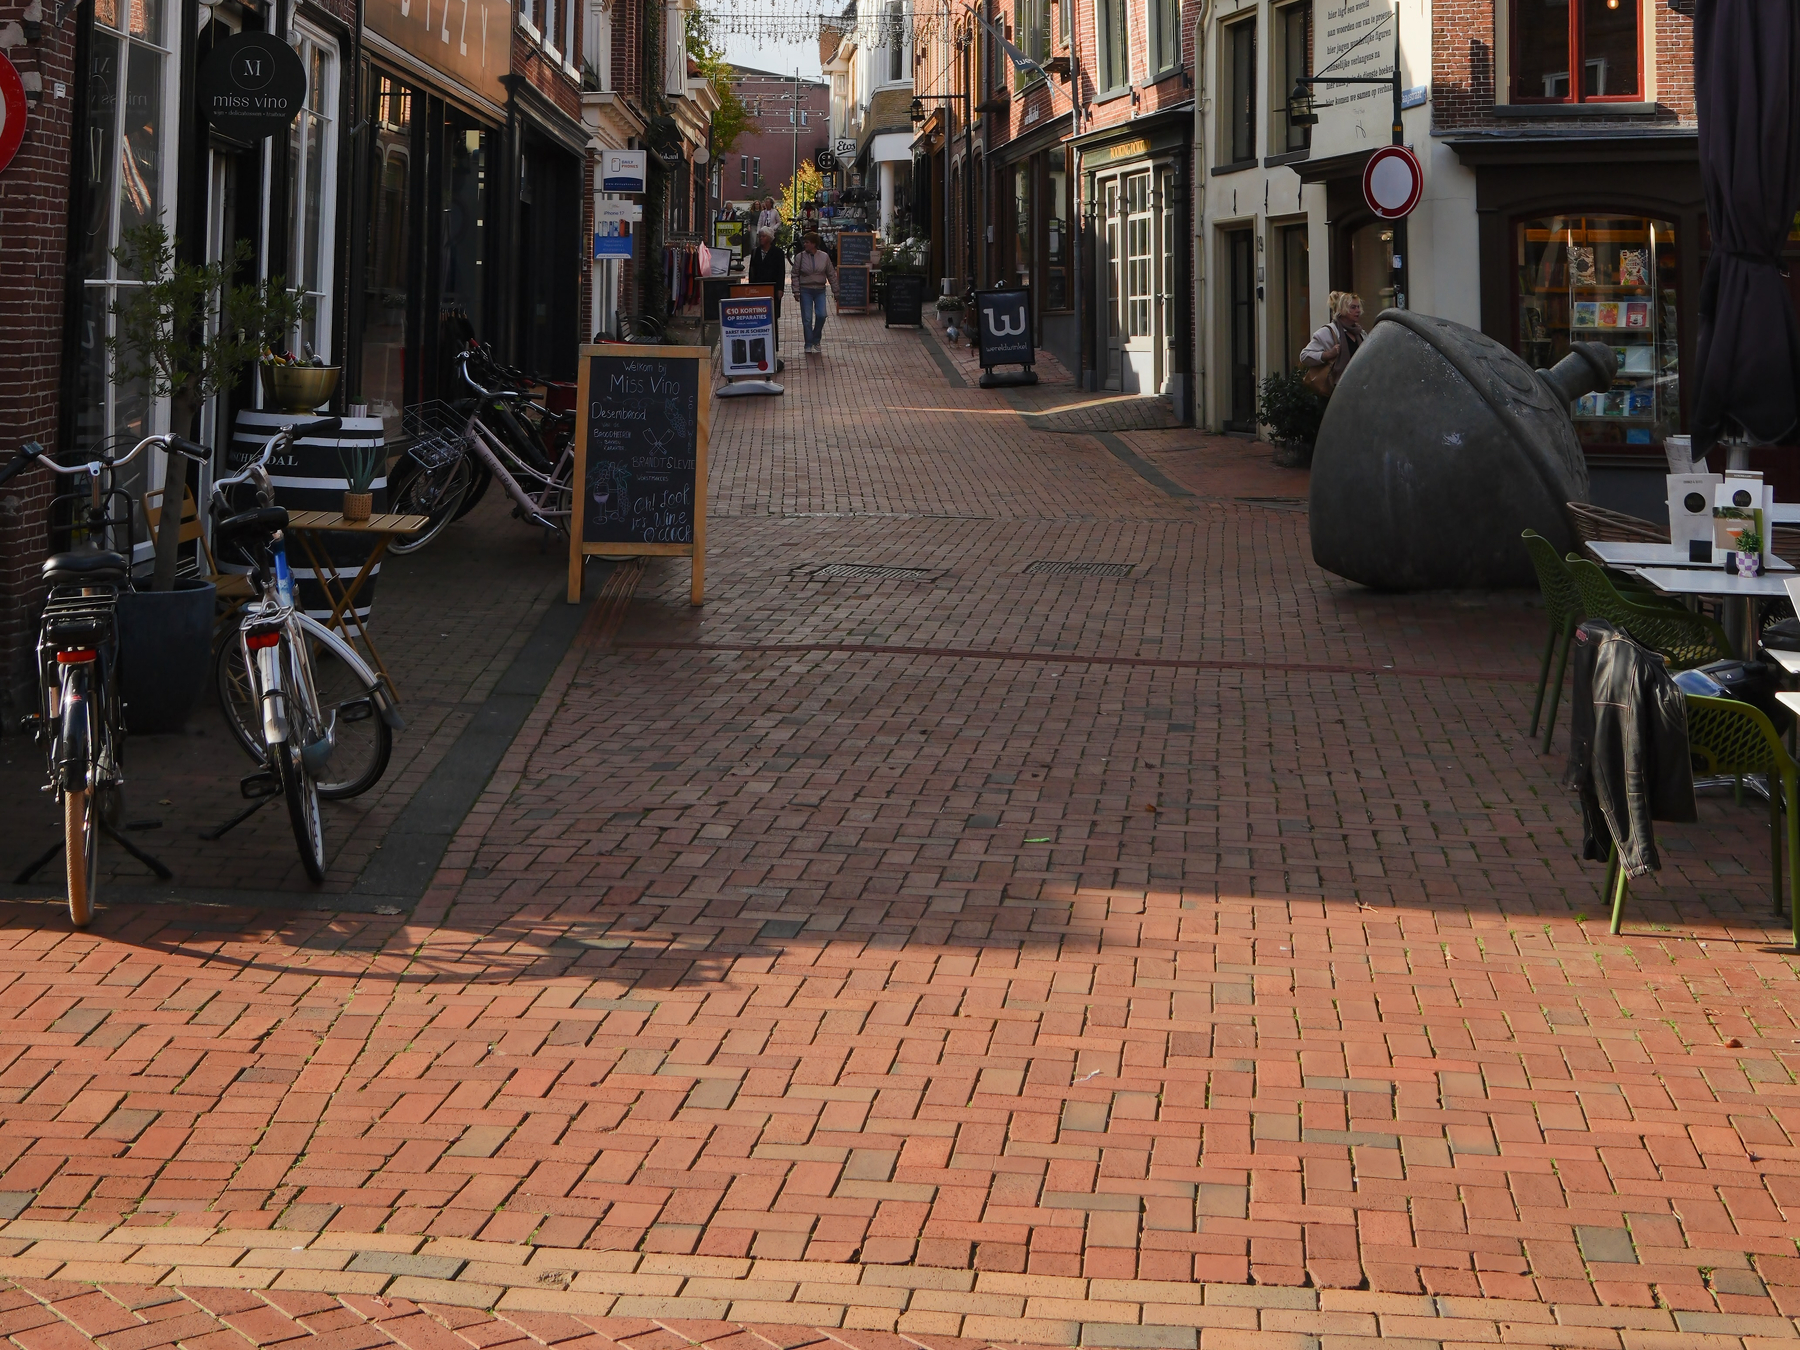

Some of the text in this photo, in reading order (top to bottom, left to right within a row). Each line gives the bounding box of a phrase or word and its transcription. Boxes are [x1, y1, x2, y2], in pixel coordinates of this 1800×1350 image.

[1327, 11, 1337, 20] hier
[1338, 7, 1346, 18] ligt
[1327, 29, 1336, 38] aan
[1336, 22, 1354, 34] woorden
[1362, 18, 1370, 26] van
[1326, 46, 1336, 54] hier
[1336, 42, 1350, 54] jagen
[1375, 29, 1392, 42] figuren
[1350, 53, 1374, 65] verlangens
[244, 59, 261, 76] M
[1378, 65, 1394, 76] boeken
[213, 92, 288, 108] miss vino
[1335, 95, 1349, 106] komen
[1356, 92, 1370, 100] samen
[1371, 88, 1376, 98] op
[1378, 83, 1394, 94] verhaa
[1402, 90, 1422, 104] aagstraat
[836, 140, 856, 151] Etos
[986, 342, 1027, 352] wereldwinkel
[610, 374, 680, 395] Miss Vino
[592, 402, 646, 420] Desembrood
[482, 454, 512, 489] ELECTRA
